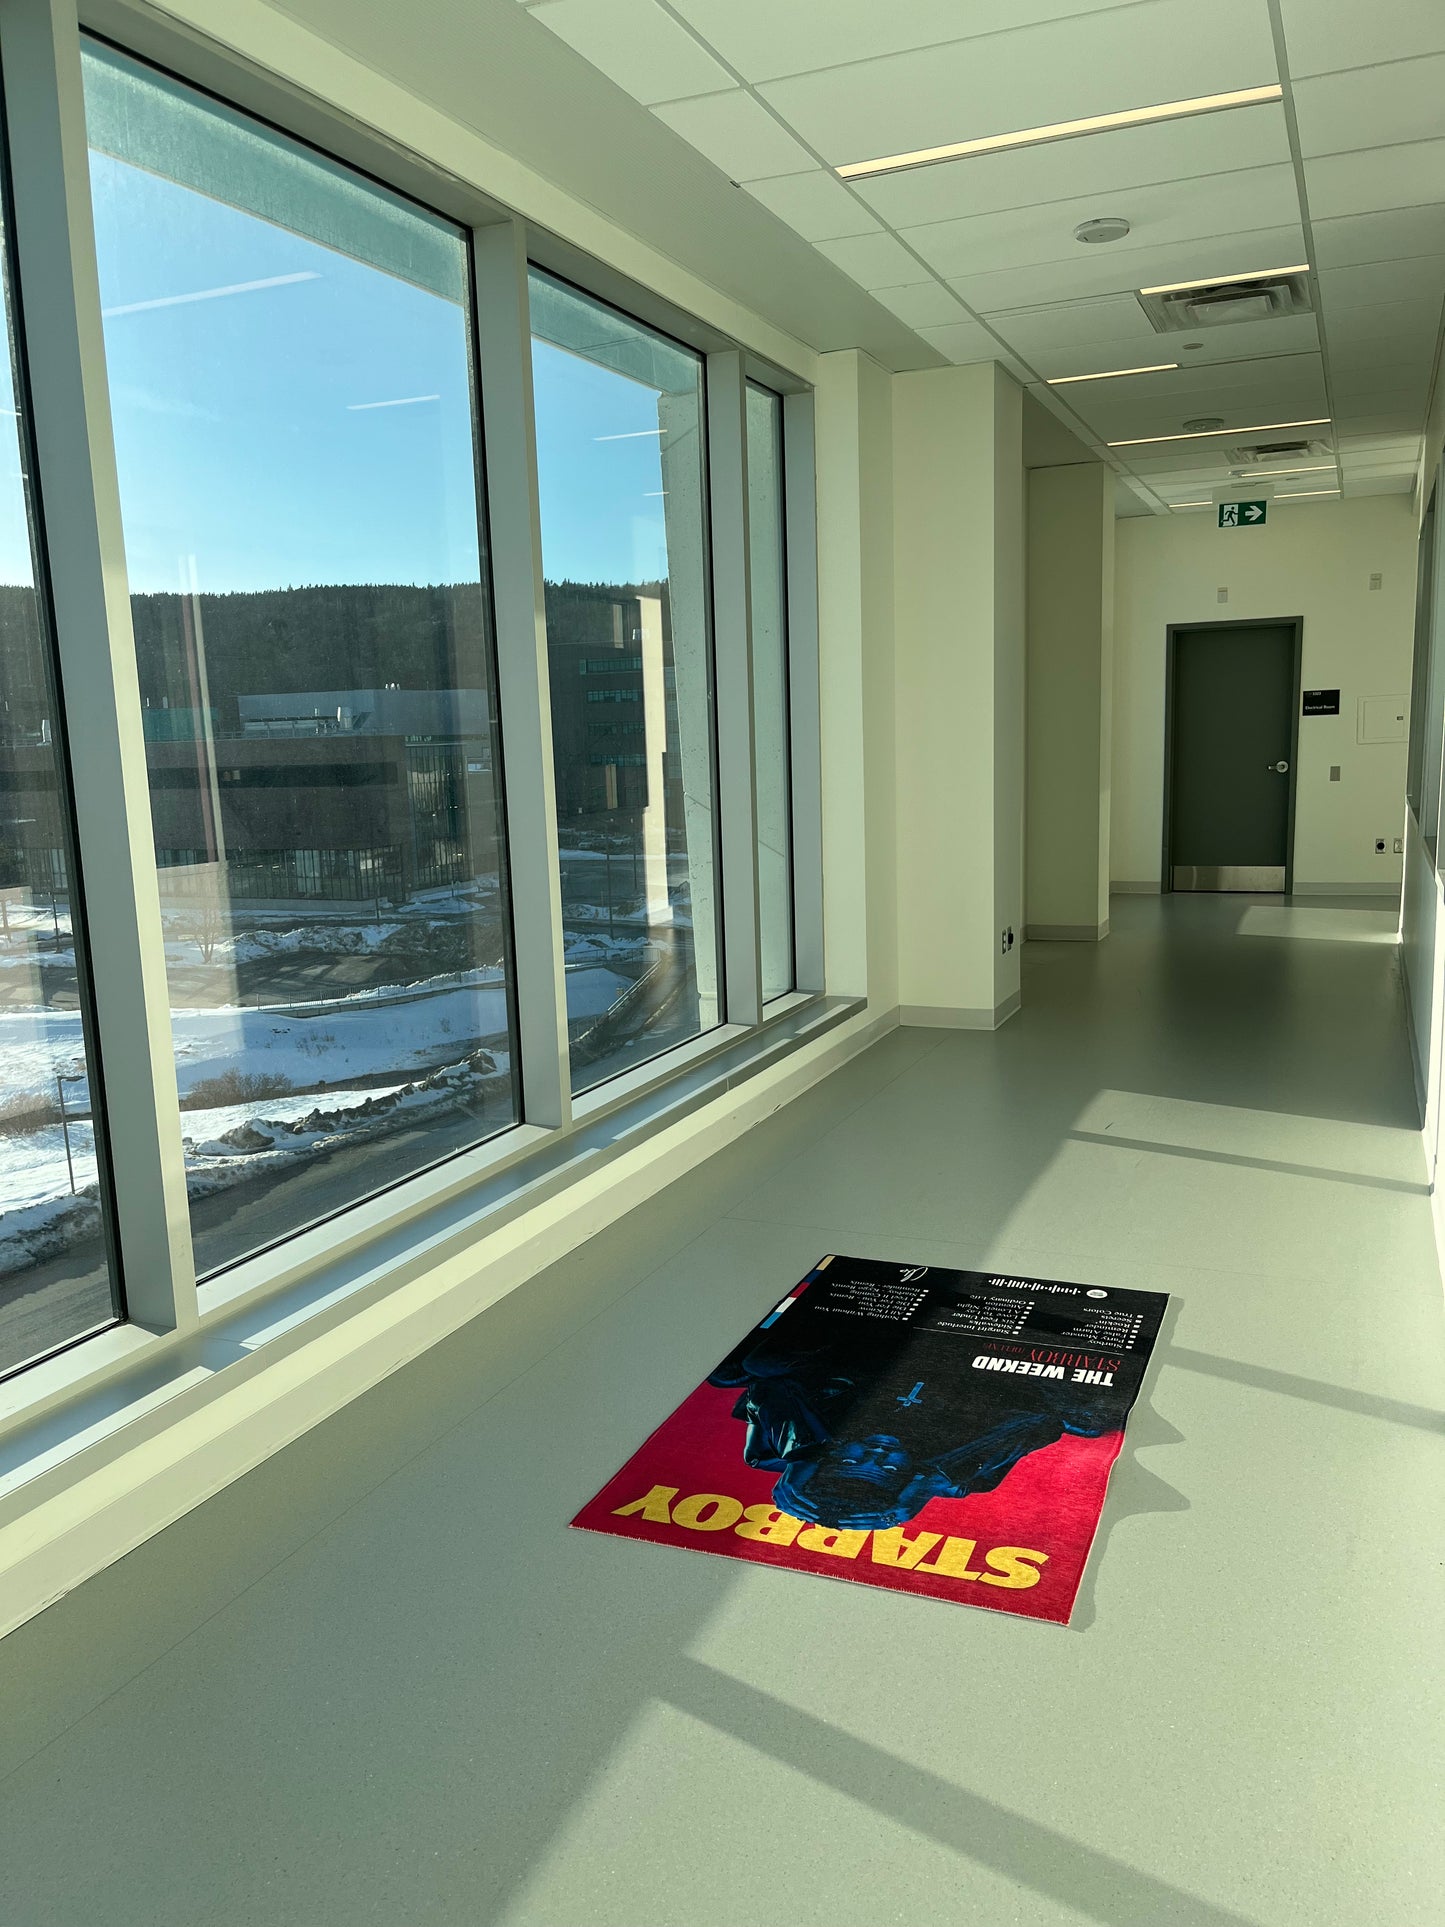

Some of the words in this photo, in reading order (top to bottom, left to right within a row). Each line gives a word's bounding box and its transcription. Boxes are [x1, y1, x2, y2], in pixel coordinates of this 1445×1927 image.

[969, 1320, 1013, 1329] Sidewalks
[1085, 1324, 1128, 1333] Reminder
[1087, 1340, 1123, 1348] Starboy
[972, 1356, 1065, 1379] WEEKND
[1027, 1349, 1121, 1371] STARBOY
[1070, 1369, 1114, 1387] THE
[610, 1484, 1051, 1589] STARBOY
